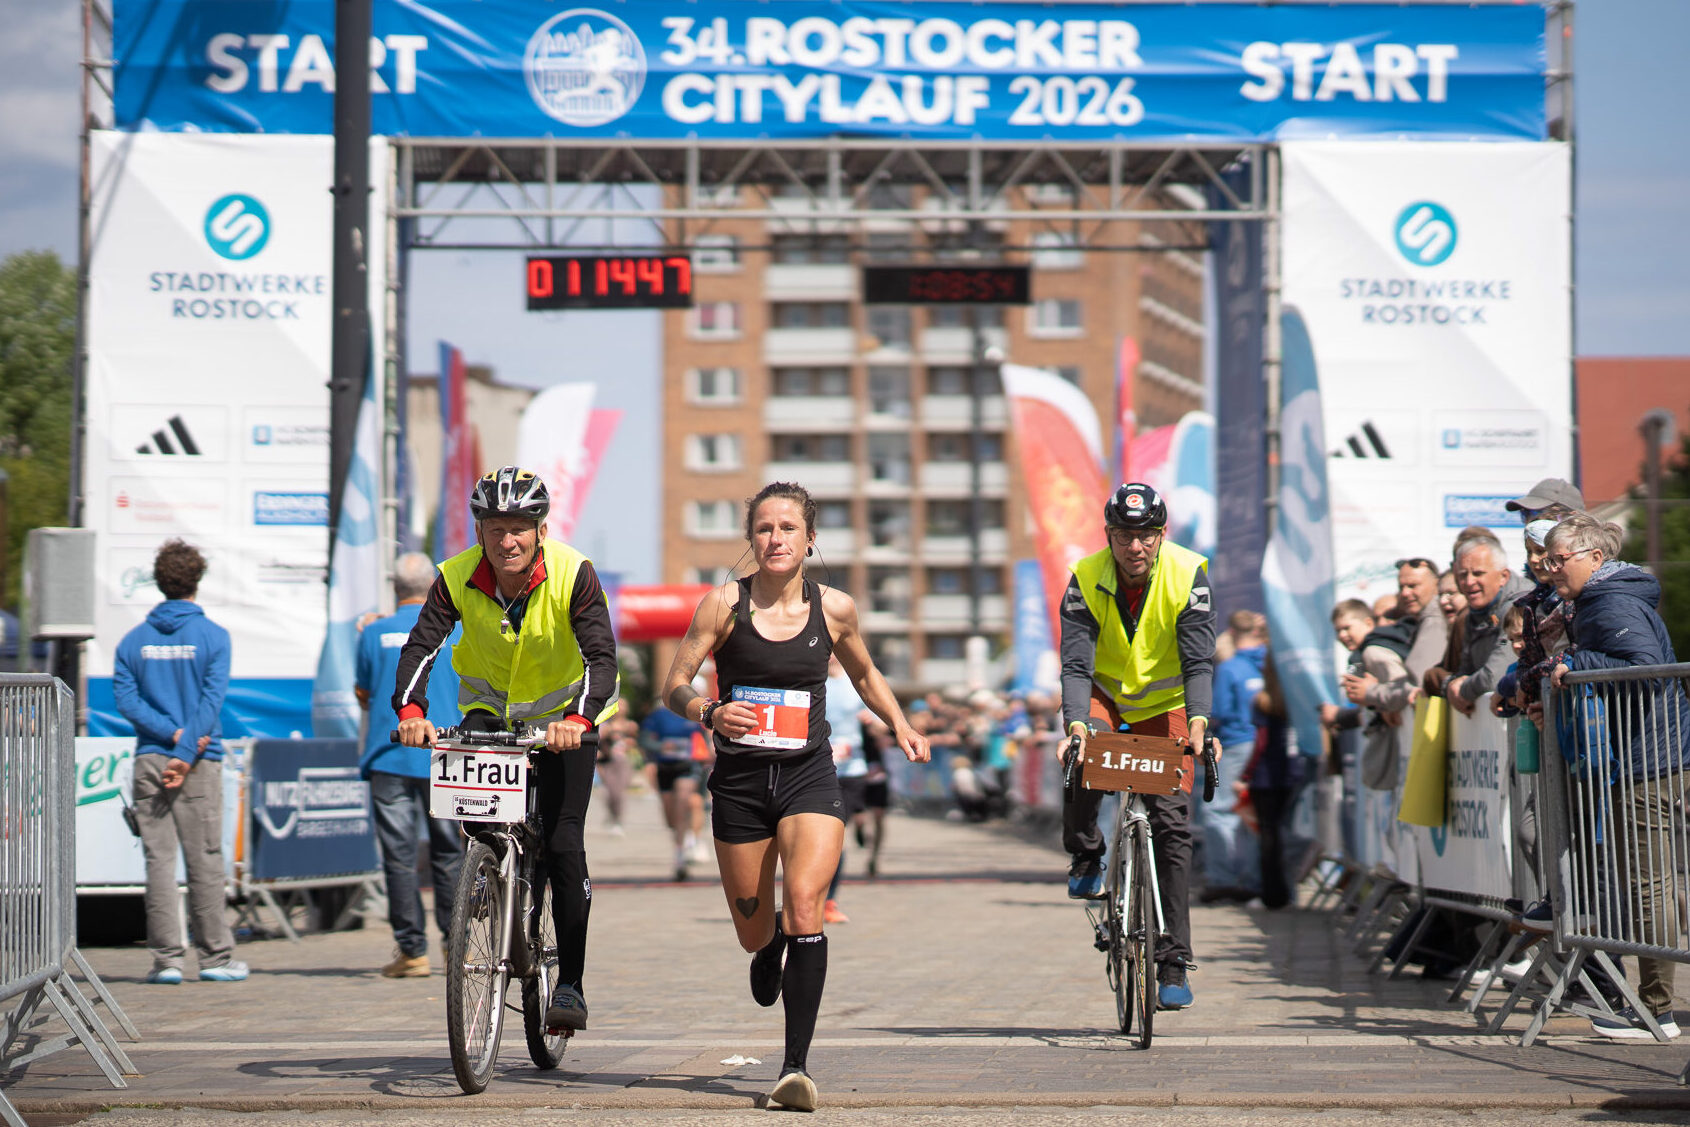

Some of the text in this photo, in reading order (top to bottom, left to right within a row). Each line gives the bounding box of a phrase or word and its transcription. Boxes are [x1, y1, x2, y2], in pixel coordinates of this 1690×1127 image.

[1240, 41, 1459, 103] START
[662, 73, 1145, 126] CITYLAUF 2026
[150, 272, 326, 295] STADTWERKE
[1340, 278, 1511, 300] STADTWERKE
[172, 299, 300, 320] ROSTOCK
[1362, 304, 1487, 325] ROSTOCK
[763, 705, 775, 730] 1
